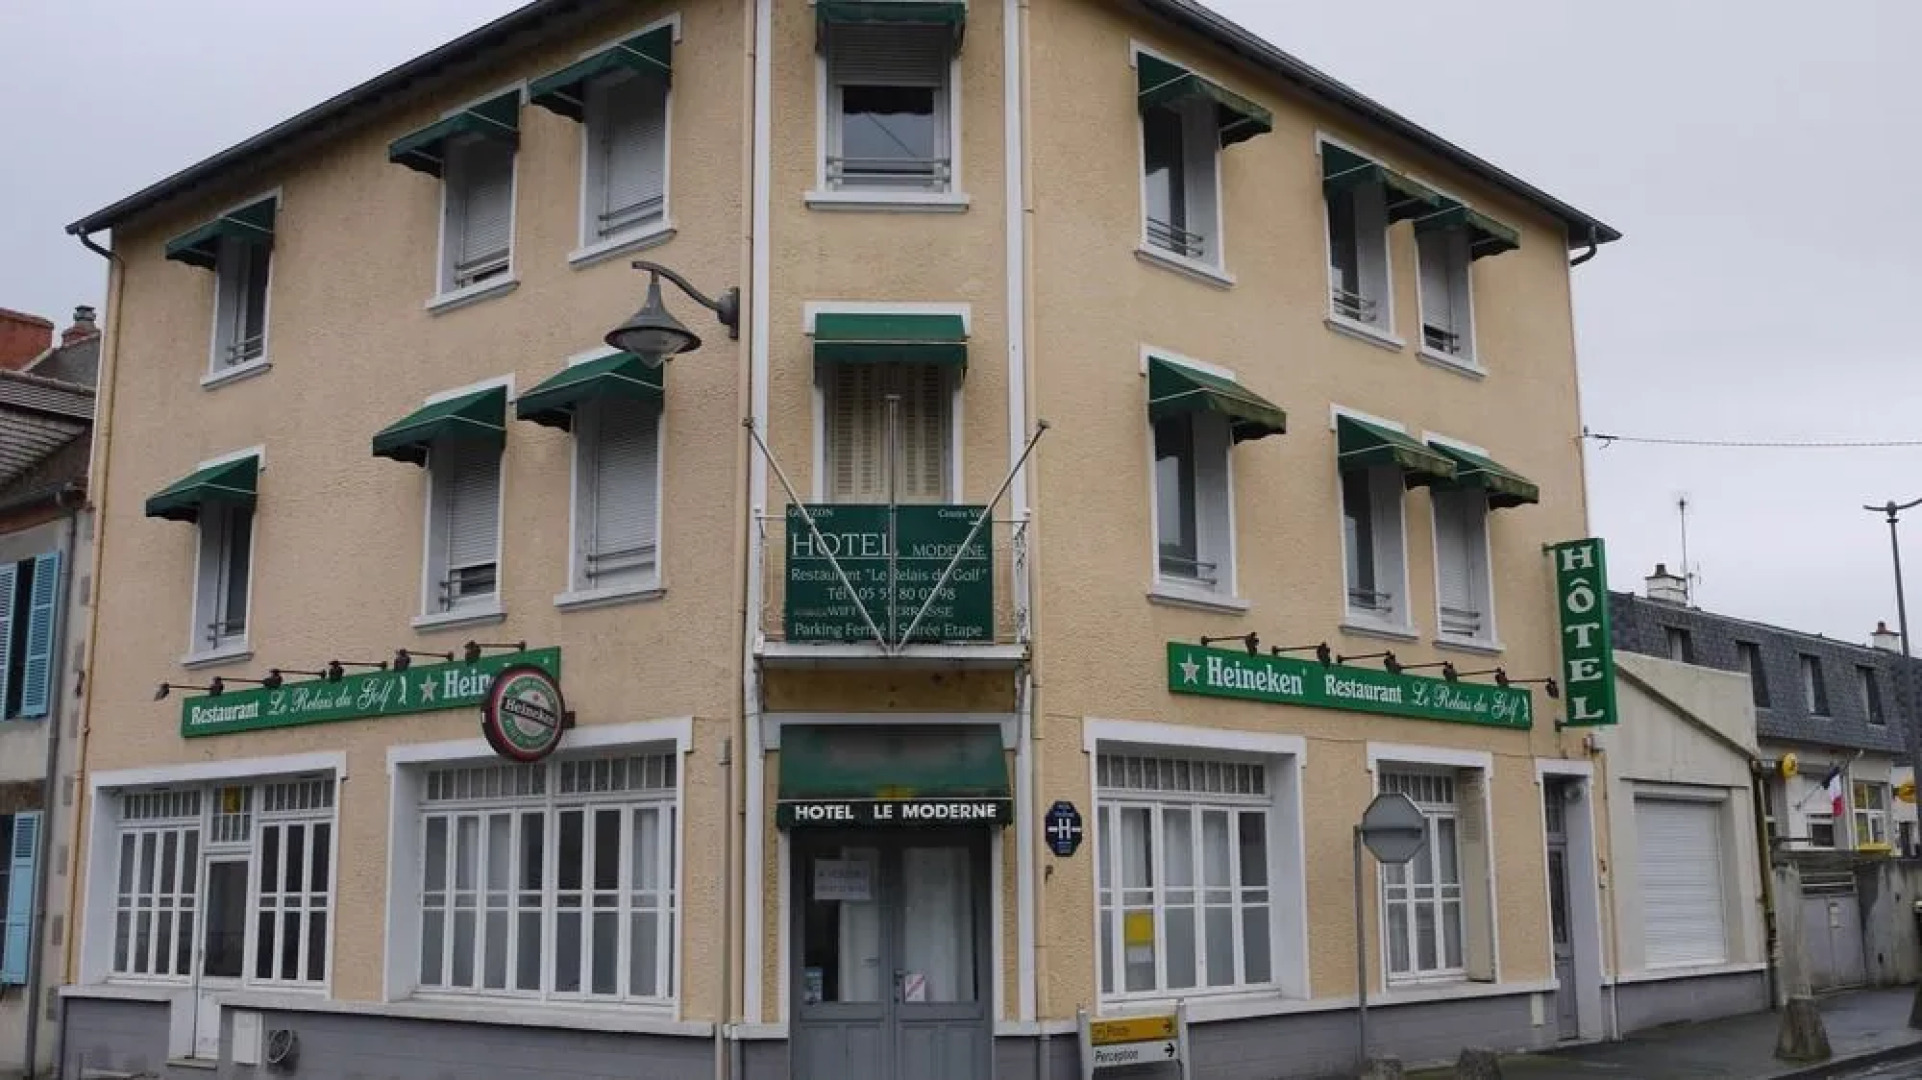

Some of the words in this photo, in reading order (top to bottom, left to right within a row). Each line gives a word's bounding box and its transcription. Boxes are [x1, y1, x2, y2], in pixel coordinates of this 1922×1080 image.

[792, 533, 899, 557] HOTEL
[791, 568, 861, 581] Restaurnt
[859, 587, 876, 601] 05
[795, 623, 842, 639] Parking
[899, 622, 940, 637] Sirée
[1561, 545, 1605, 720] HÔTEL
[1206, 656, 1304, 695] Heineken
[1324, 673, 1402, 704] Restaurant
[190, 699, 259, 725] Restaurant
[795, 805, 854, 820] HOTEL
[874, 805, 893, 819] LE
[902, 804, 996, 819] MODERNE
